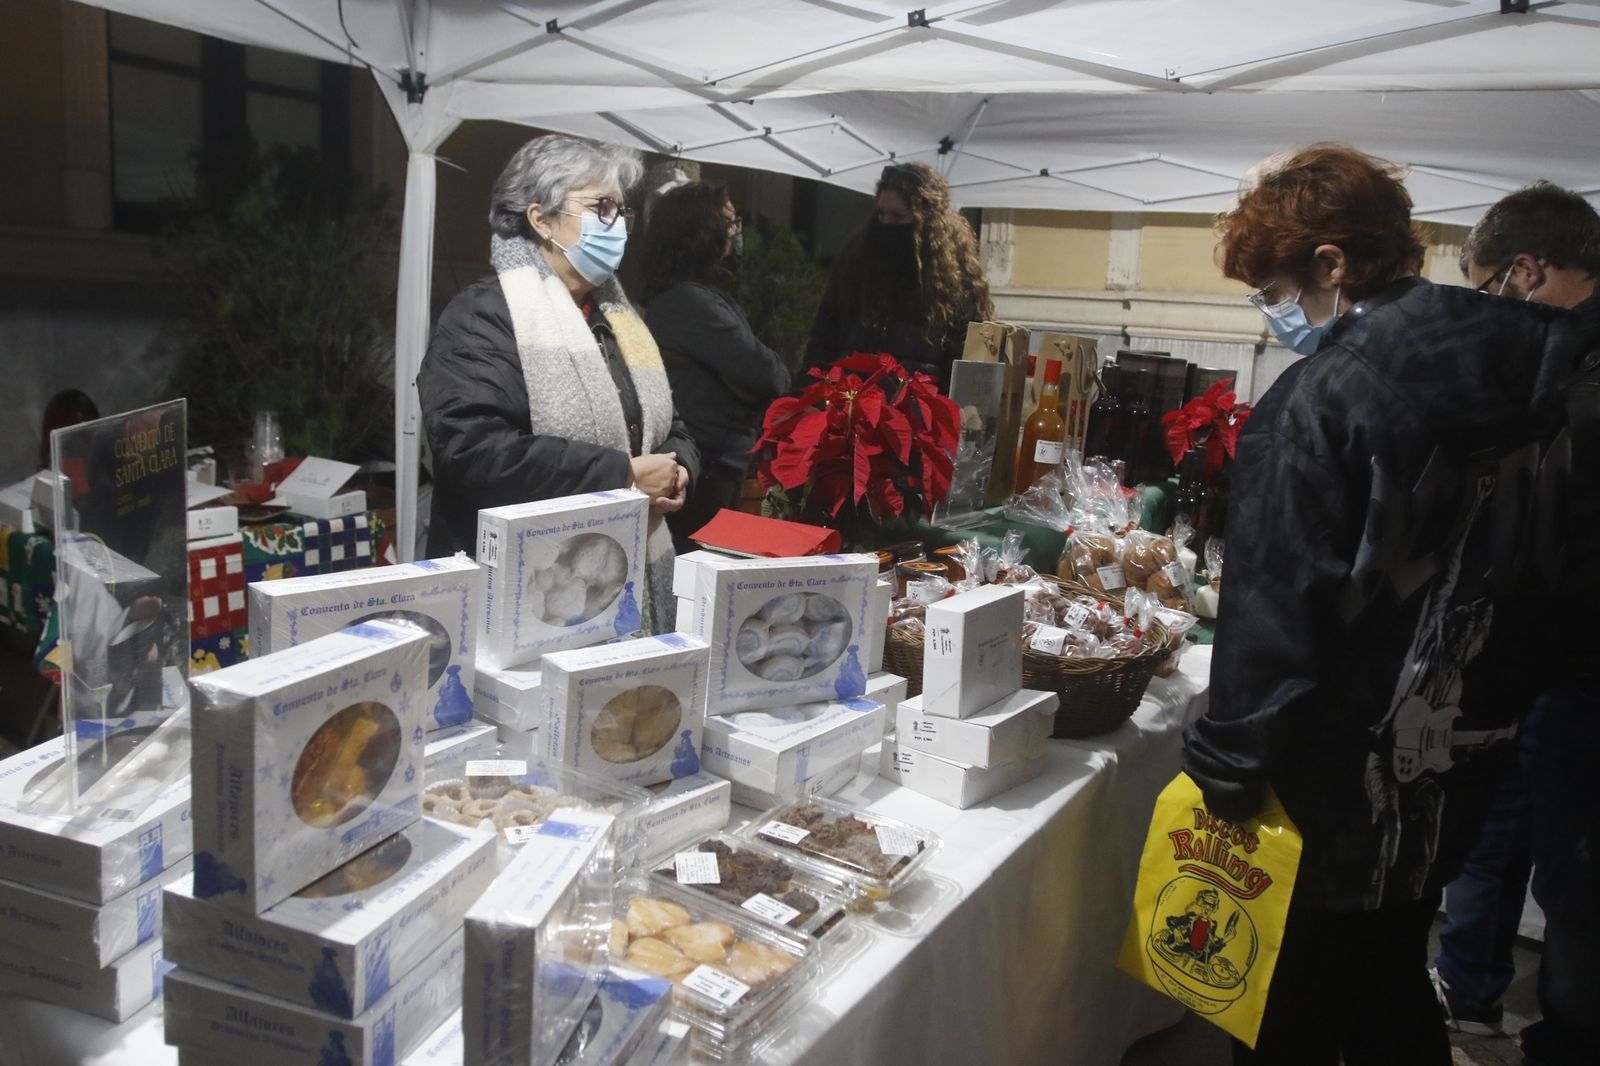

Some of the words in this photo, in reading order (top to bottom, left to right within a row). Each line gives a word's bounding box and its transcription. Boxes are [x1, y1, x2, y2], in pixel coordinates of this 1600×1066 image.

[114, 428, 161, 458] CONVENTO
[164, 421, 176, 443] DE
[115, 460, 146, 487] SANTA
[149, 446, 177, 473] CLARA
[526, 526, 560, 538] Convento
[562, 523, 571, 532] de
[587, 518, 604, 528] Clara
[737, 579, 775, 590] Convento
[777, 578, 786, 588] de
[806, 578, 826, 587] Clara
[300, 602, 350, 617] Convento
[353, 599, 364, 610] de
[390, 593, 416, 604] Clara
[272, 689, 324, 717] Convento
[326, 685, 338, 697] de
[363, 667, 386, 684] Clara
[578, 674, 613, 686] Convento
[615, 671, 623, 680] de
[715, 747, 751, 767] Artesanos
[1168, 828, 1273, 897] Rolling
[222, 920, 289, 954] Alfajores
[225, 1005, 296, 1037] Alfajores
